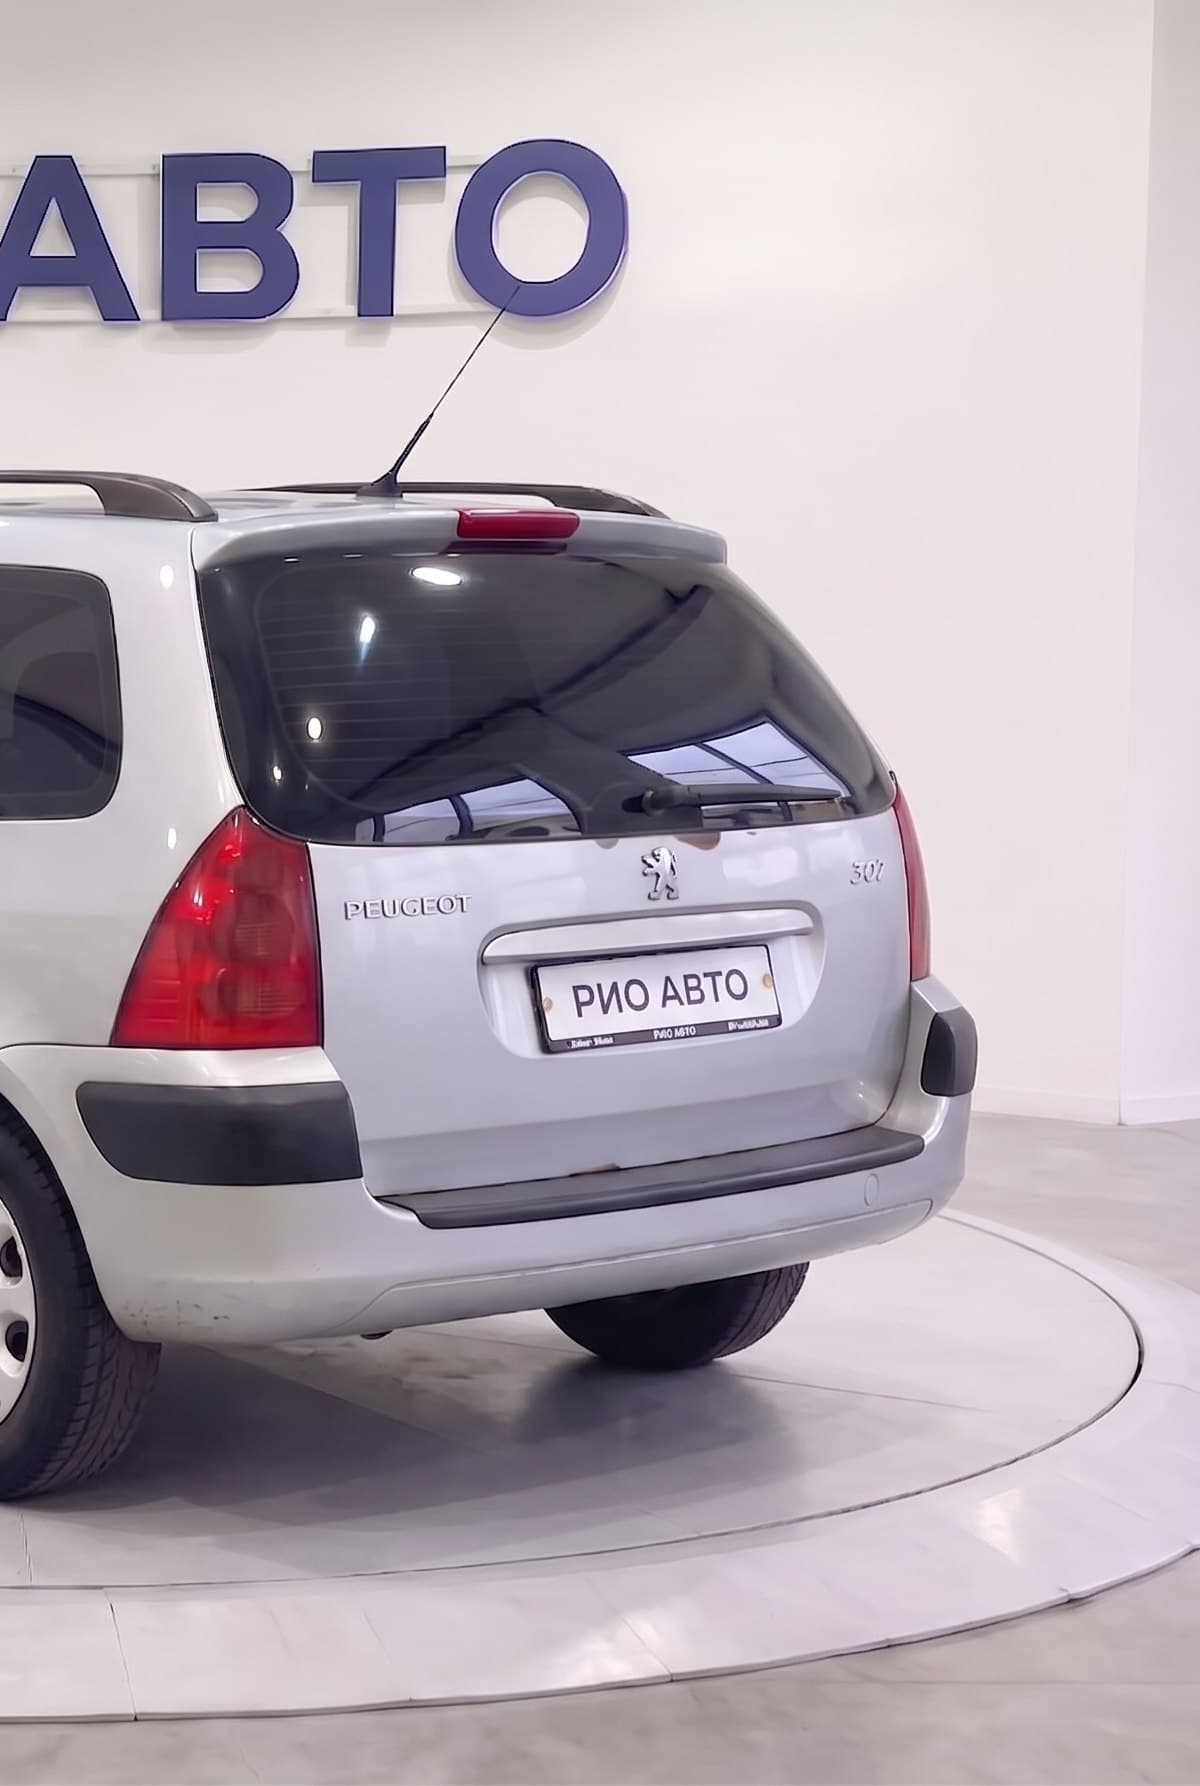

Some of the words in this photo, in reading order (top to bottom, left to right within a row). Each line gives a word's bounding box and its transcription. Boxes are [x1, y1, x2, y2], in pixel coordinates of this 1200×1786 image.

[850, 858, 885, 886] 307
[343, 893, 473, 921] PEUGEOT
[571, 977, 650, 1019] РИО
[660, 968, 750, 1009] АВТО
